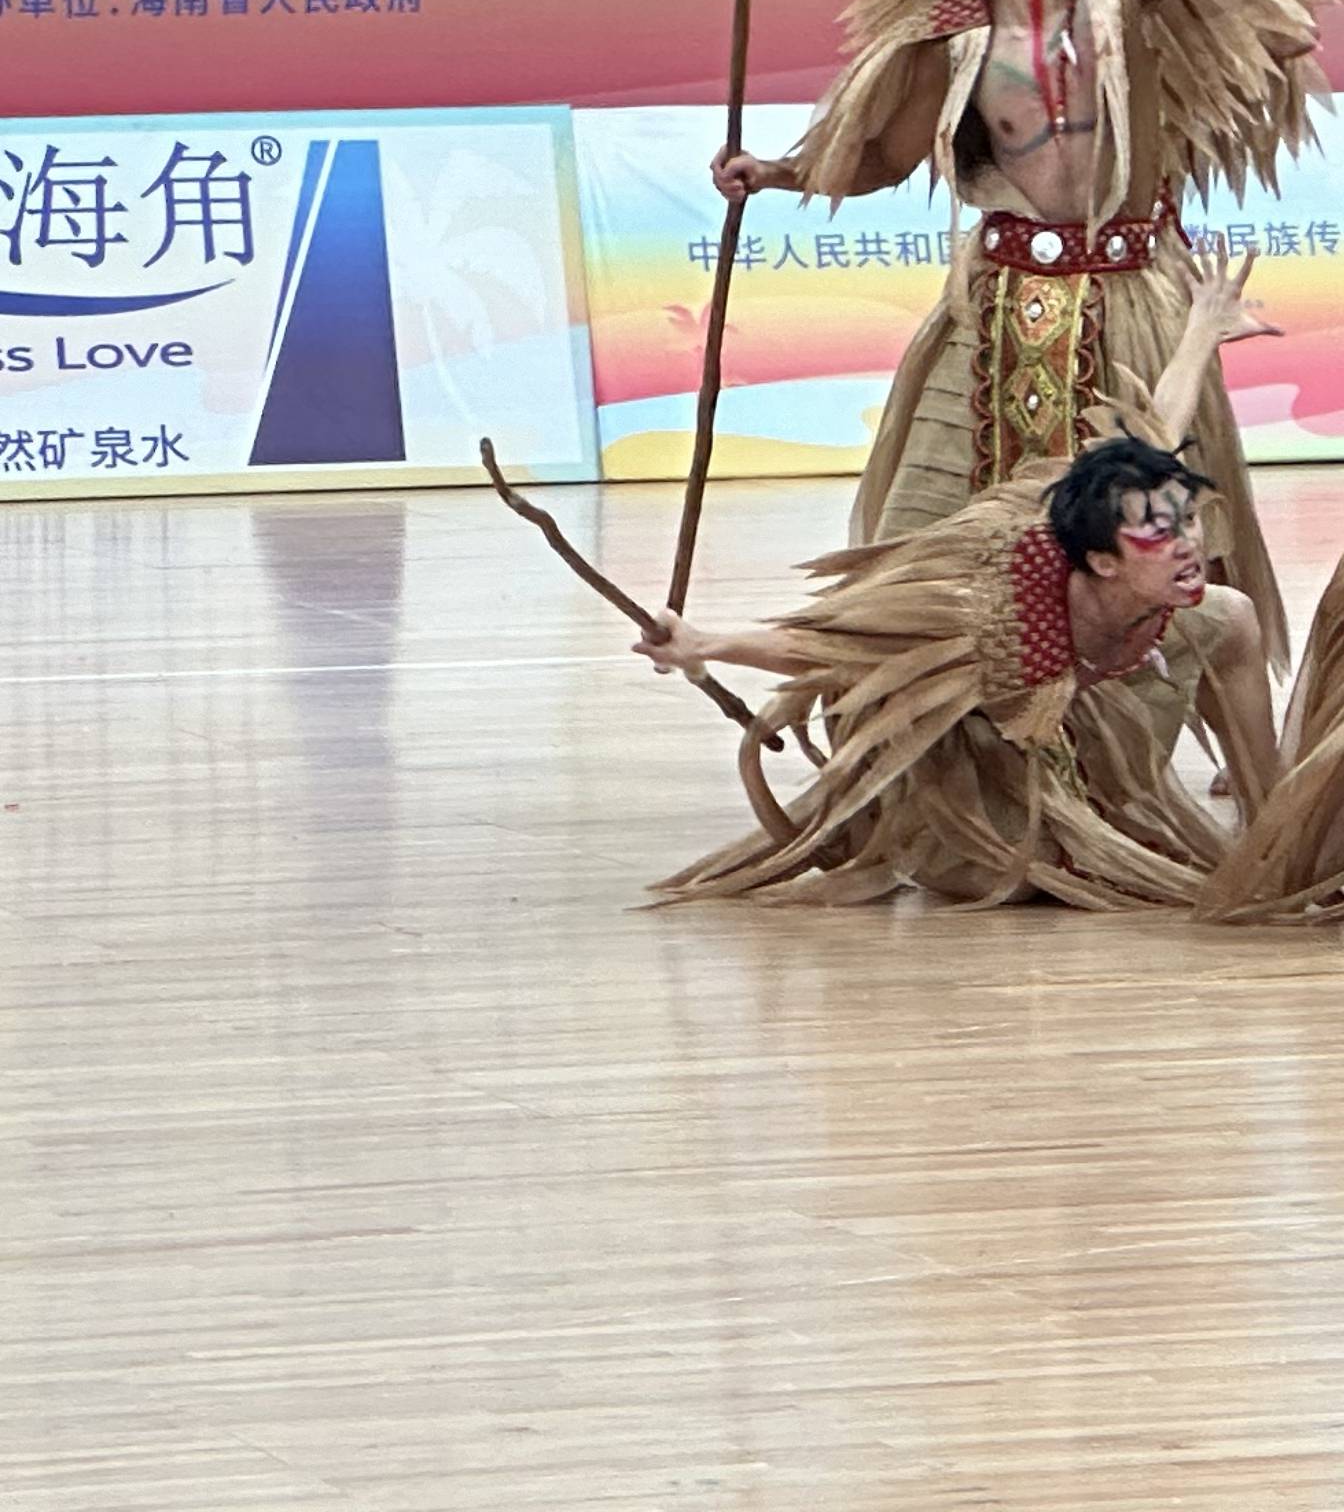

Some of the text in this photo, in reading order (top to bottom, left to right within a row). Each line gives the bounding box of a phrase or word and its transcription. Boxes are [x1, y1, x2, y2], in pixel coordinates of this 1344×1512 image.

[0, 336, 194, 372] s Love
[0, 424, 190, 472] 然矿泉水
